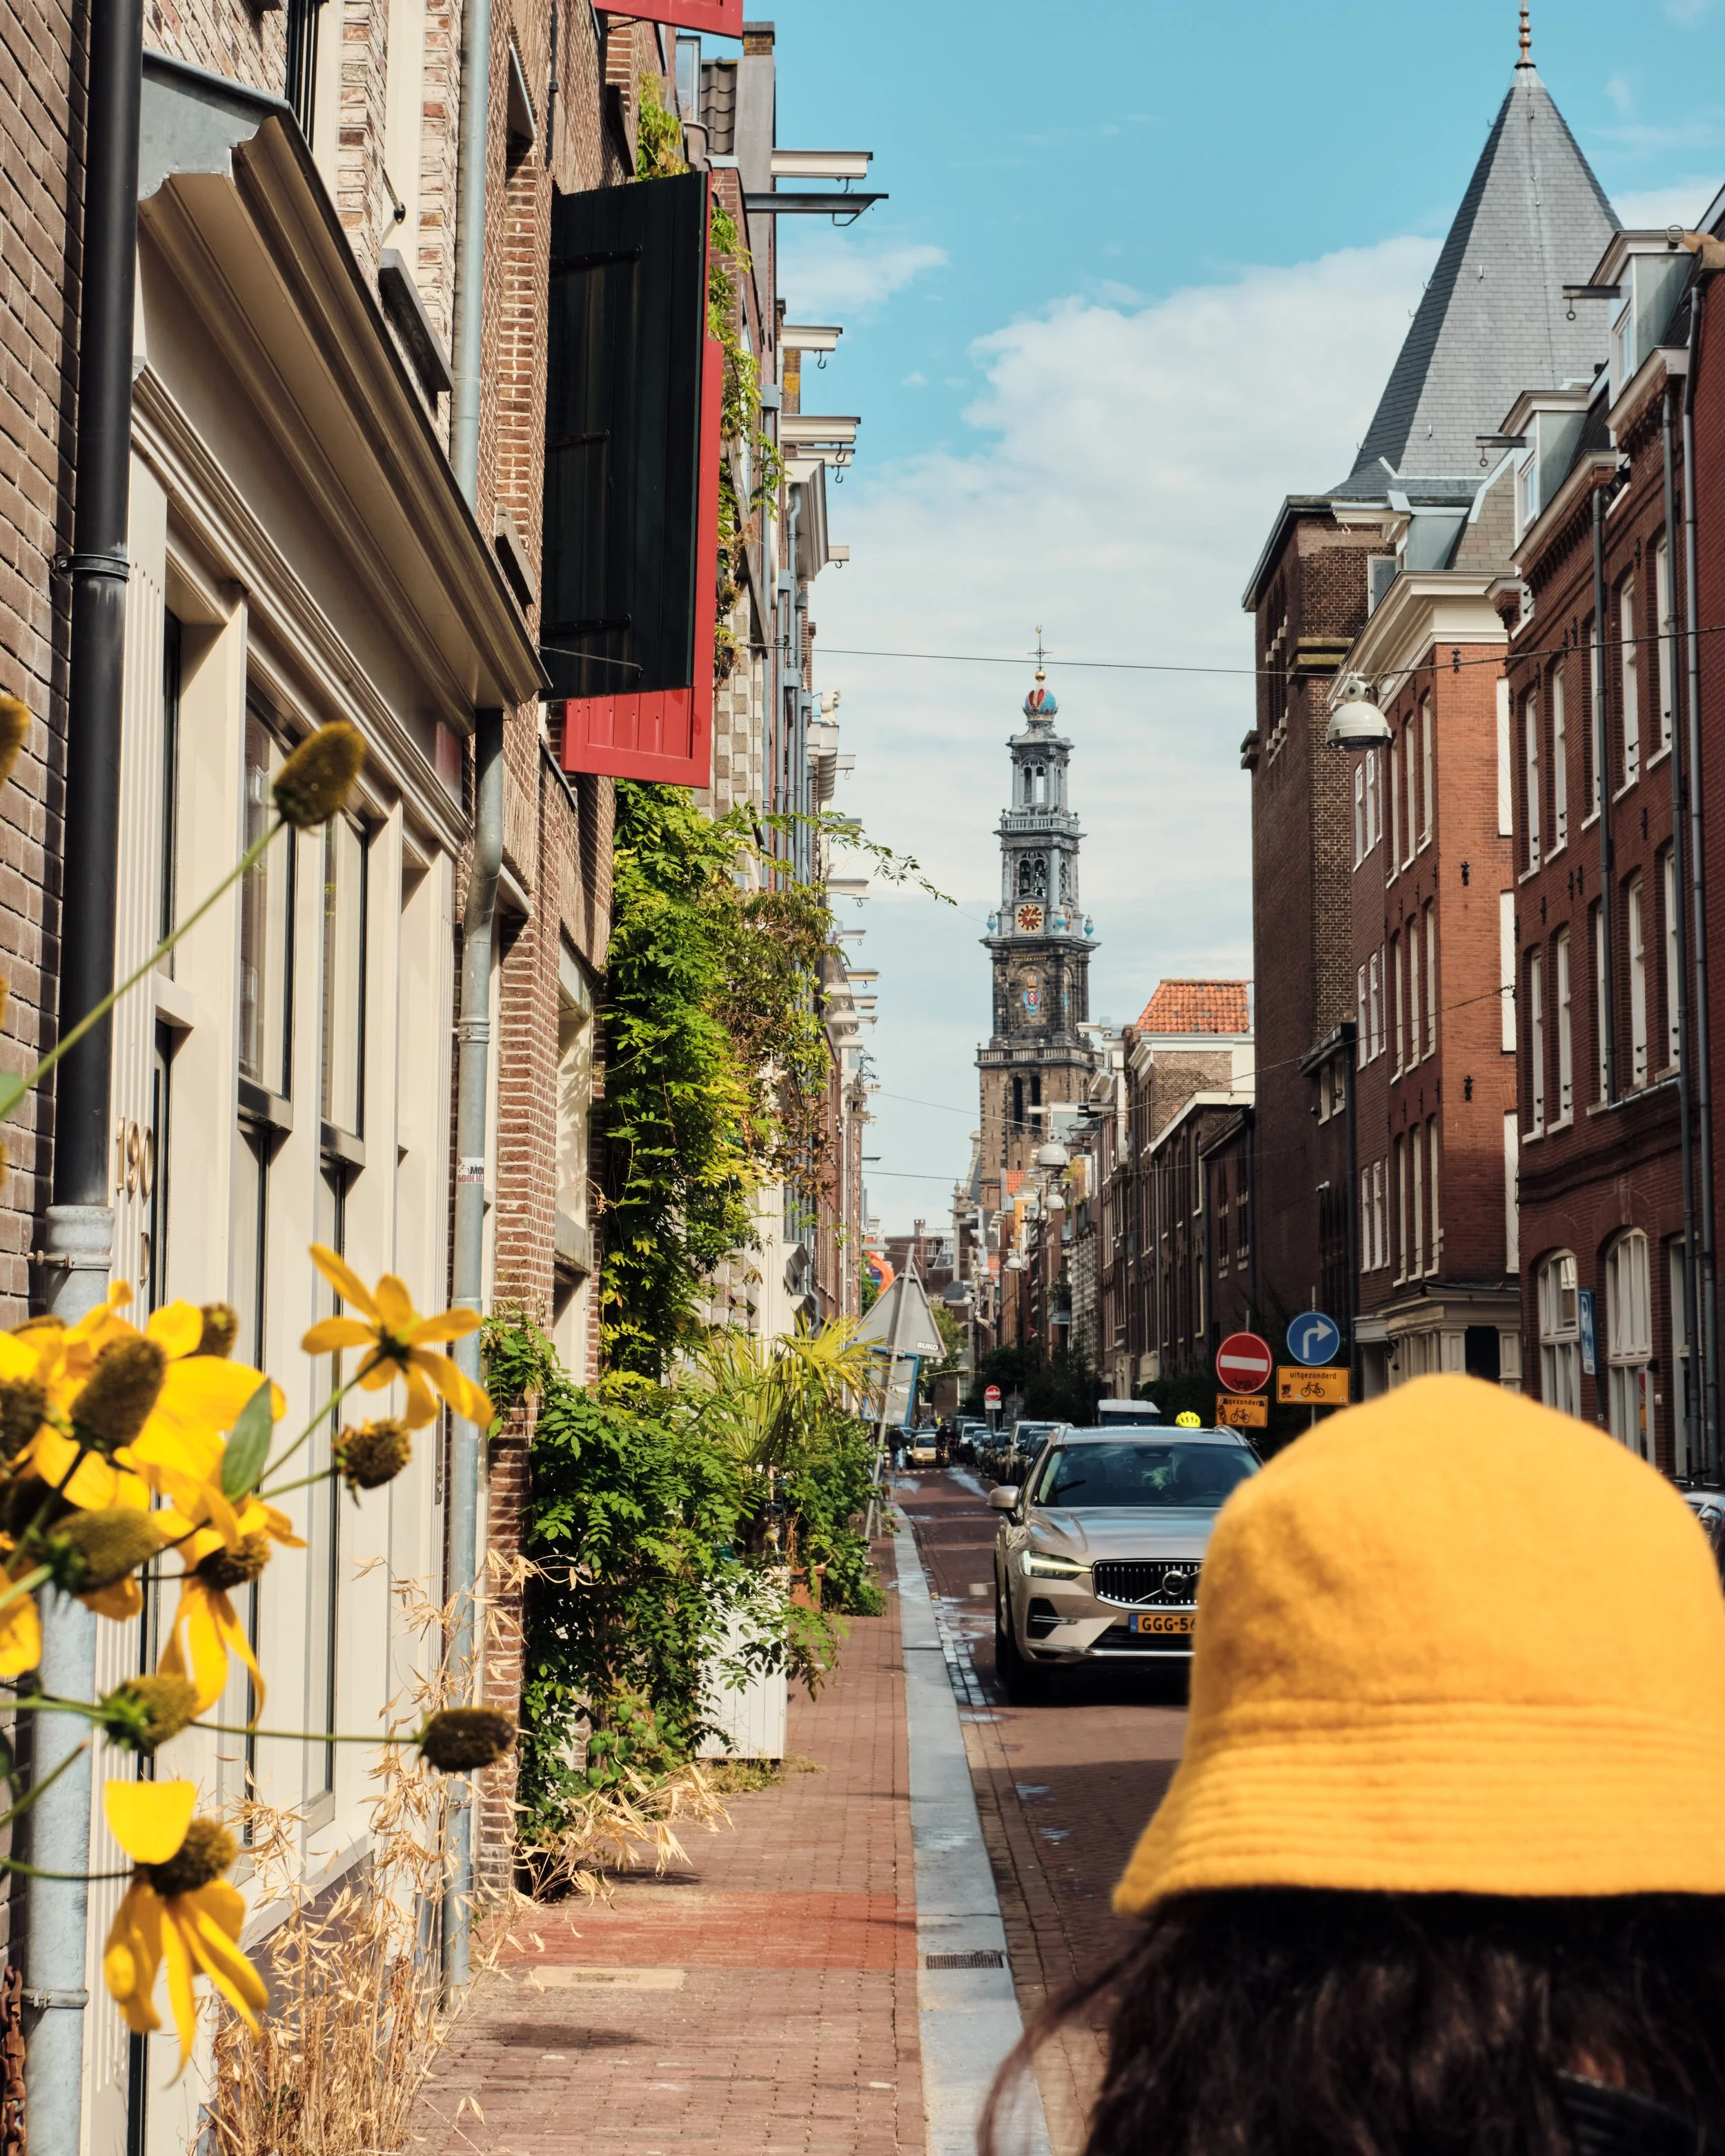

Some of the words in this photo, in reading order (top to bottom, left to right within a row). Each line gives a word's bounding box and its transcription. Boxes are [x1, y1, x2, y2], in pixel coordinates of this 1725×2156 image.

[116, 1115, 154, 1198] 190
[916, 1341, 938, 1351] BUKO
[1290, 1372, 1337, 1380] uitgezonderd
[1220, 1398, 1264, 1406] gezonder
